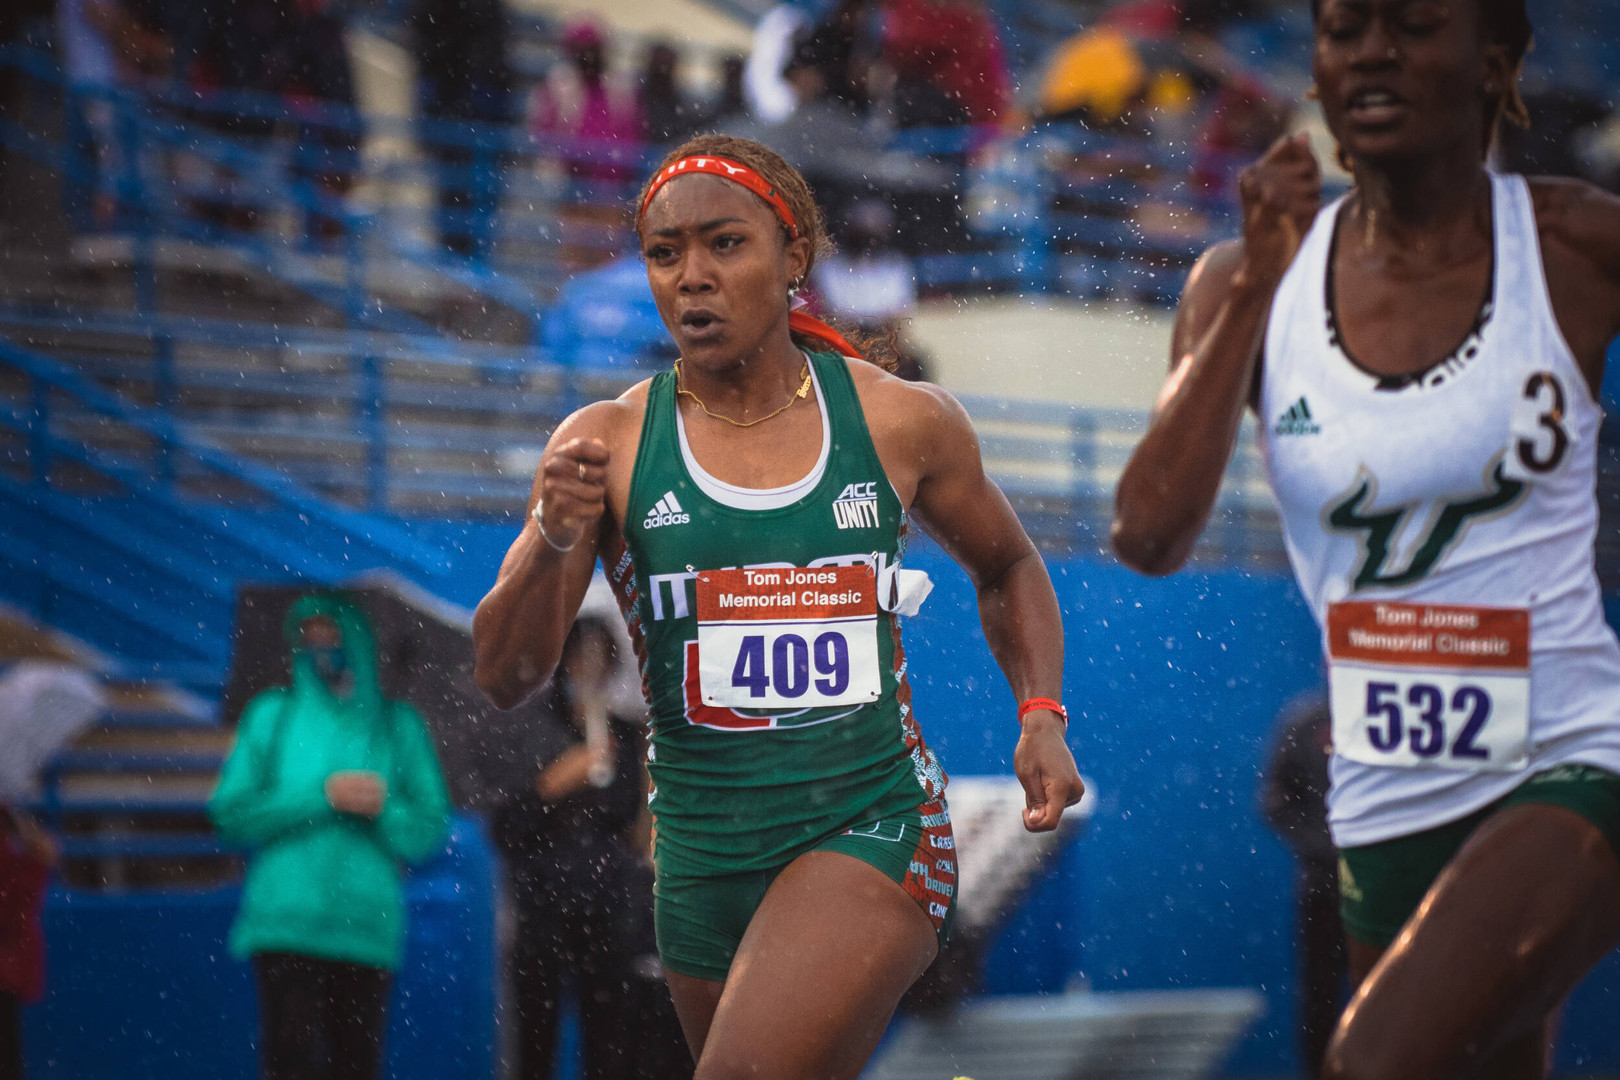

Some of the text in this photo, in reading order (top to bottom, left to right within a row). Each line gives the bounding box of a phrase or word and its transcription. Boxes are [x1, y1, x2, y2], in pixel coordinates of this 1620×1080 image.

[1518, 371, 1569, 473] 3
[838, 481, 878, 499] ACC
[643, 511, 690, 530] adidas
[832, 500, 880, 529] UNITY
[744, 571, 837, 586] Tom Jones
[719, 590, 862, 608] Memorial Classic
[1374, 606, 1416, 627] Tom
[731, 631, 850, 699] 409
[1366, 681, 1492, 760] 532
